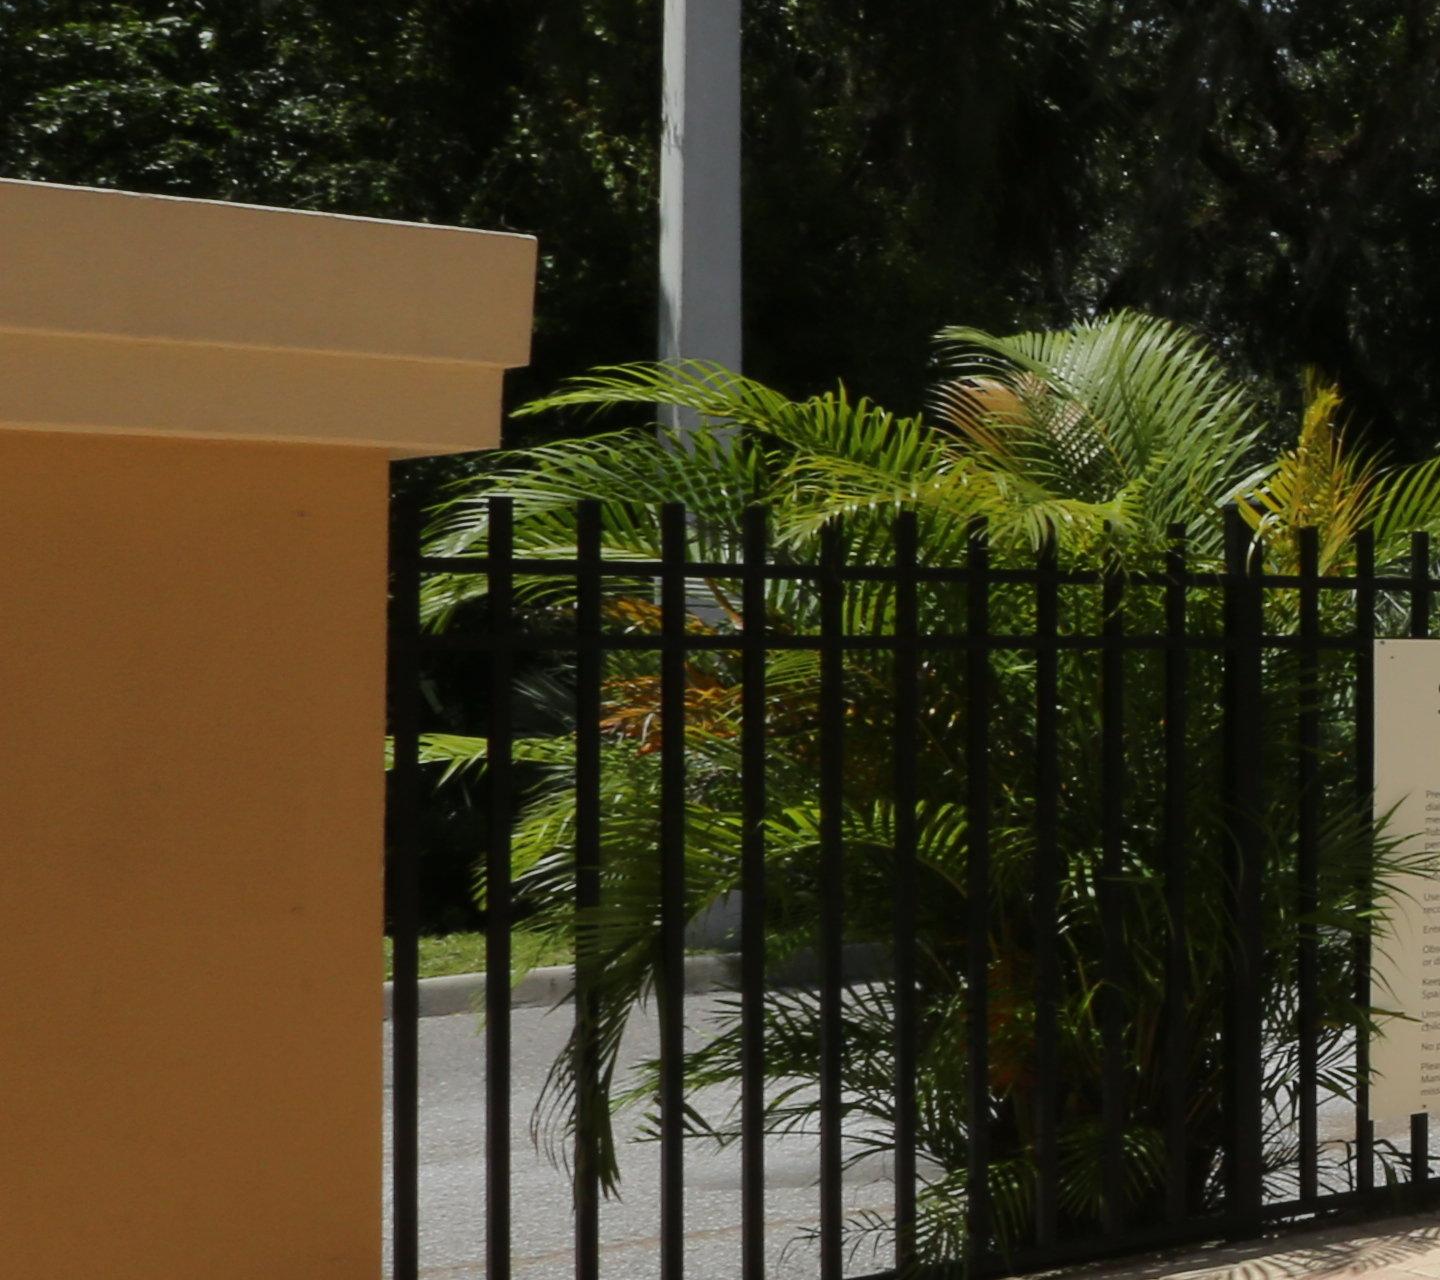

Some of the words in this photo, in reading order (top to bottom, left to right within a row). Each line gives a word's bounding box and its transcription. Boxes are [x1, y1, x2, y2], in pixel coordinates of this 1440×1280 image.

[1424, 893, 1440, 902] Use
[1423, 959, 1431, 967] or
[1421, 1043, 1434, 1051] No
